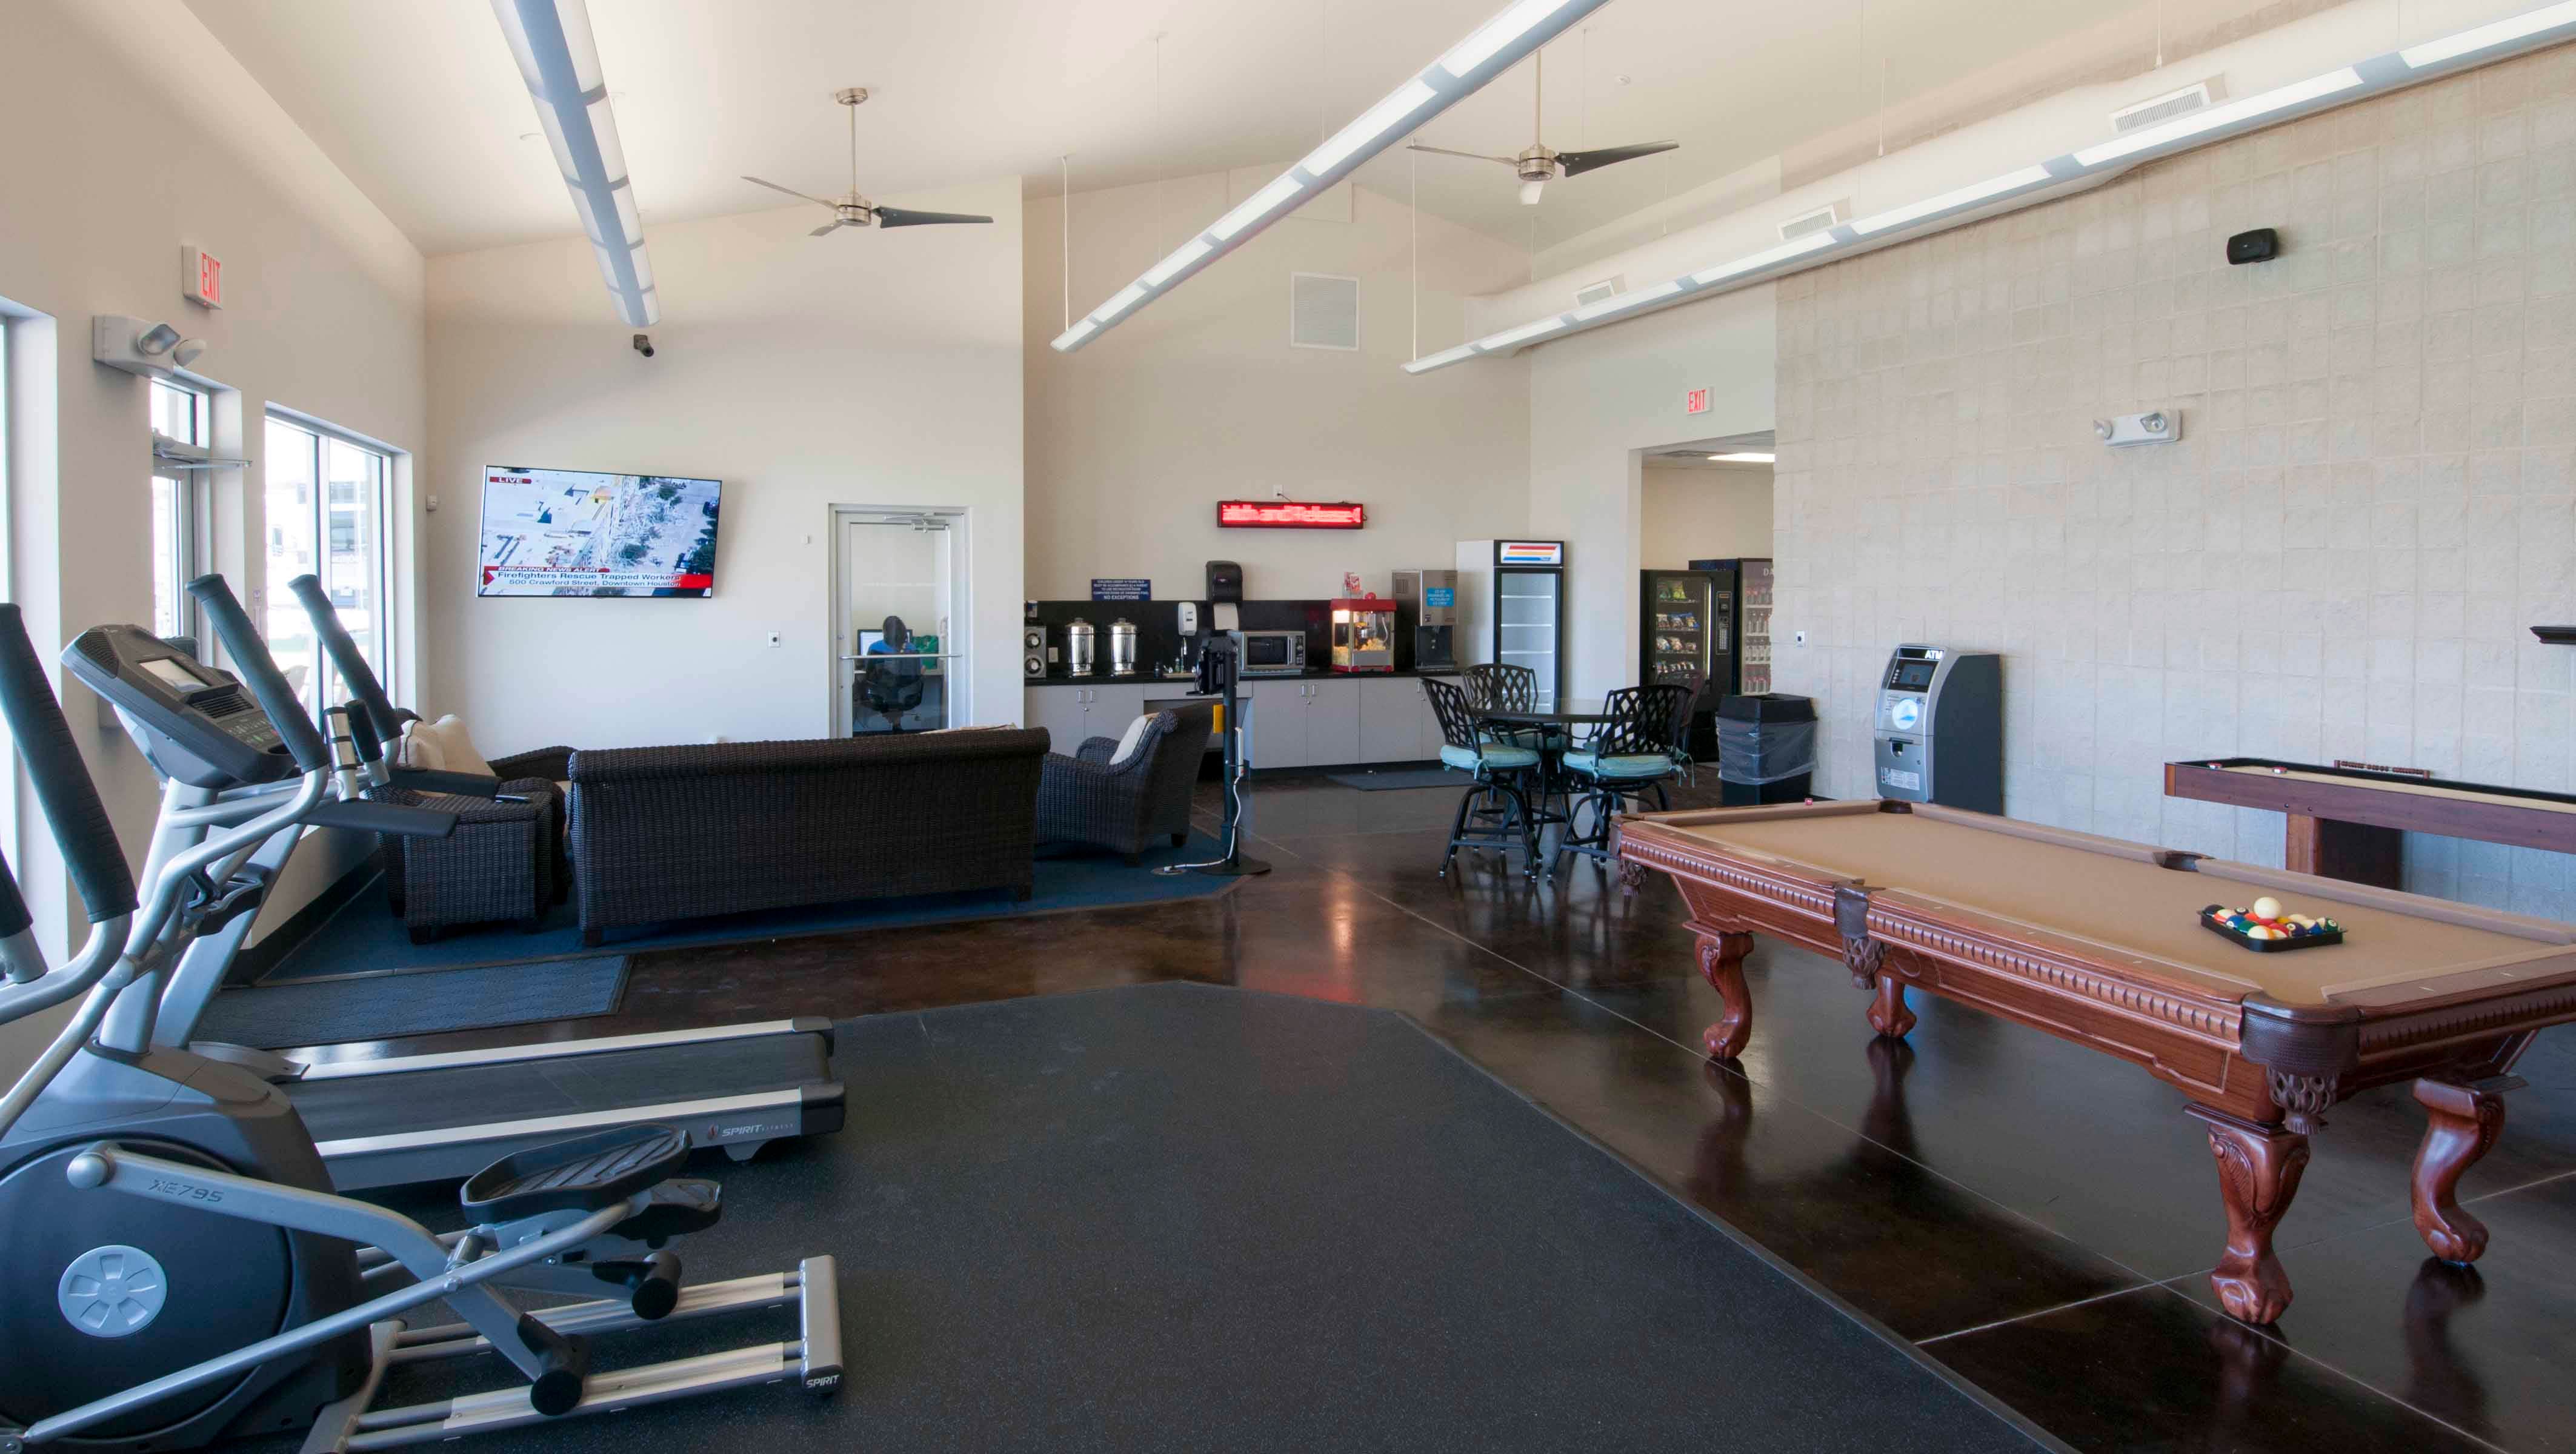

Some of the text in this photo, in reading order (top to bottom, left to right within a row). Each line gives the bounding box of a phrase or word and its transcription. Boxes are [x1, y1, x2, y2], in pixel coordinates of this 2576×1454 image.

[201, 252, 221, 304] EXIT
[1688, 389, 1706, 413] EXIT
[722, 1124, 762, 1137] SPIRIT
[148, 1179, 225, 1203] XE795
[805, 1374, 840, 1389] SPIRIT
